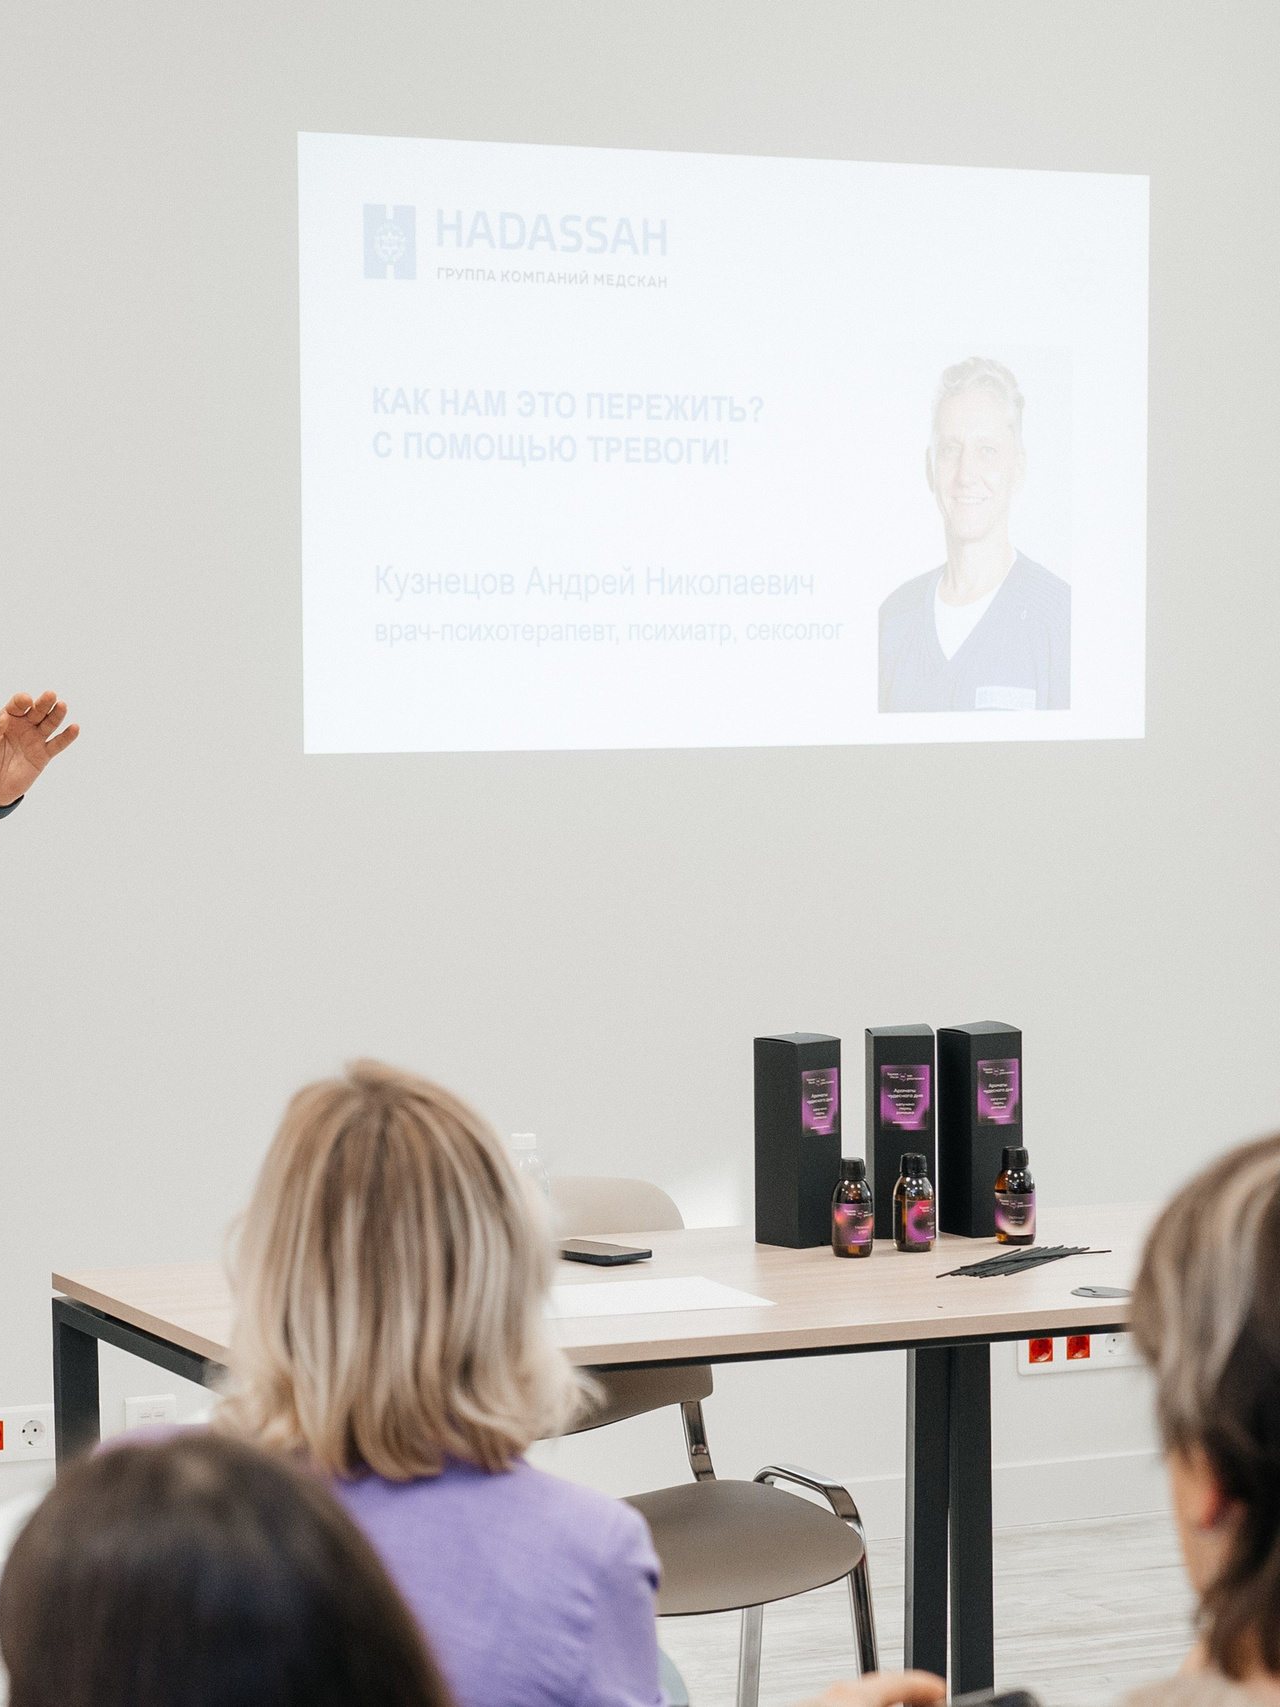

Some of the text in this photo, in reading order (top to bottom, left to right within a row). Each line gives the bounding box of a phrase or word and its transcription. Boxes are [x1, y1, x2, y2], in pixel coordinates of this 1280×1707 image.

[436, 208, 668, 257] HADASSAH
[436, 266, 668, 290] ГРУППА КОМПАНИЙ МЕДСКАН
[372, 386, 764, 424] КАК НАМ ЭТО ПЕРЕЖИТЬ?
[372, 430, 730, 467] С ПОМОЩЬЮ ТРЕВОГИ!
[374, 564, 815, 602] Кузнецов Андрей Николаевич
[374, 619, 844, 648] врач-психотерапевт, психиатр, сексолог
